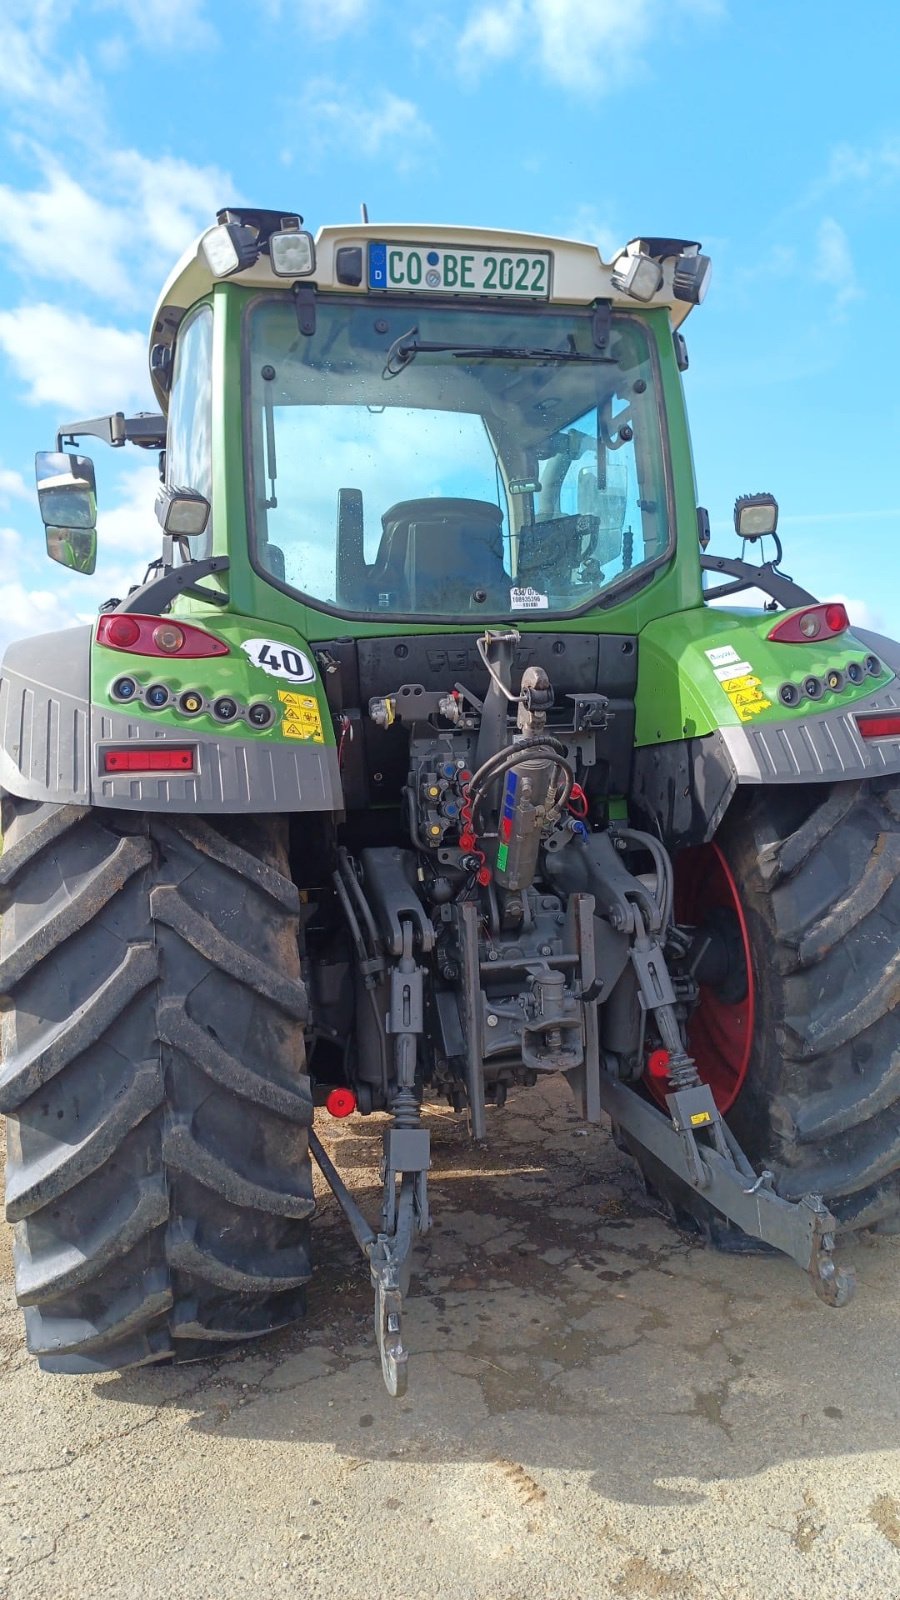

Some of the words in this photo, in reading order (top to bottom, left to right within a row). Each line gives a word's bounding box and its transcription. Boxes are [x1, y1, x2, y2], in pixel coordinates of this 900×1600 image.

[375, 270, 382, 280] D
[388, 251, 422, 285] CO
[443, 254, 475, 288] BE
[482, 256, 546, 292] 2022
[258, 644, 304, 676] 40
